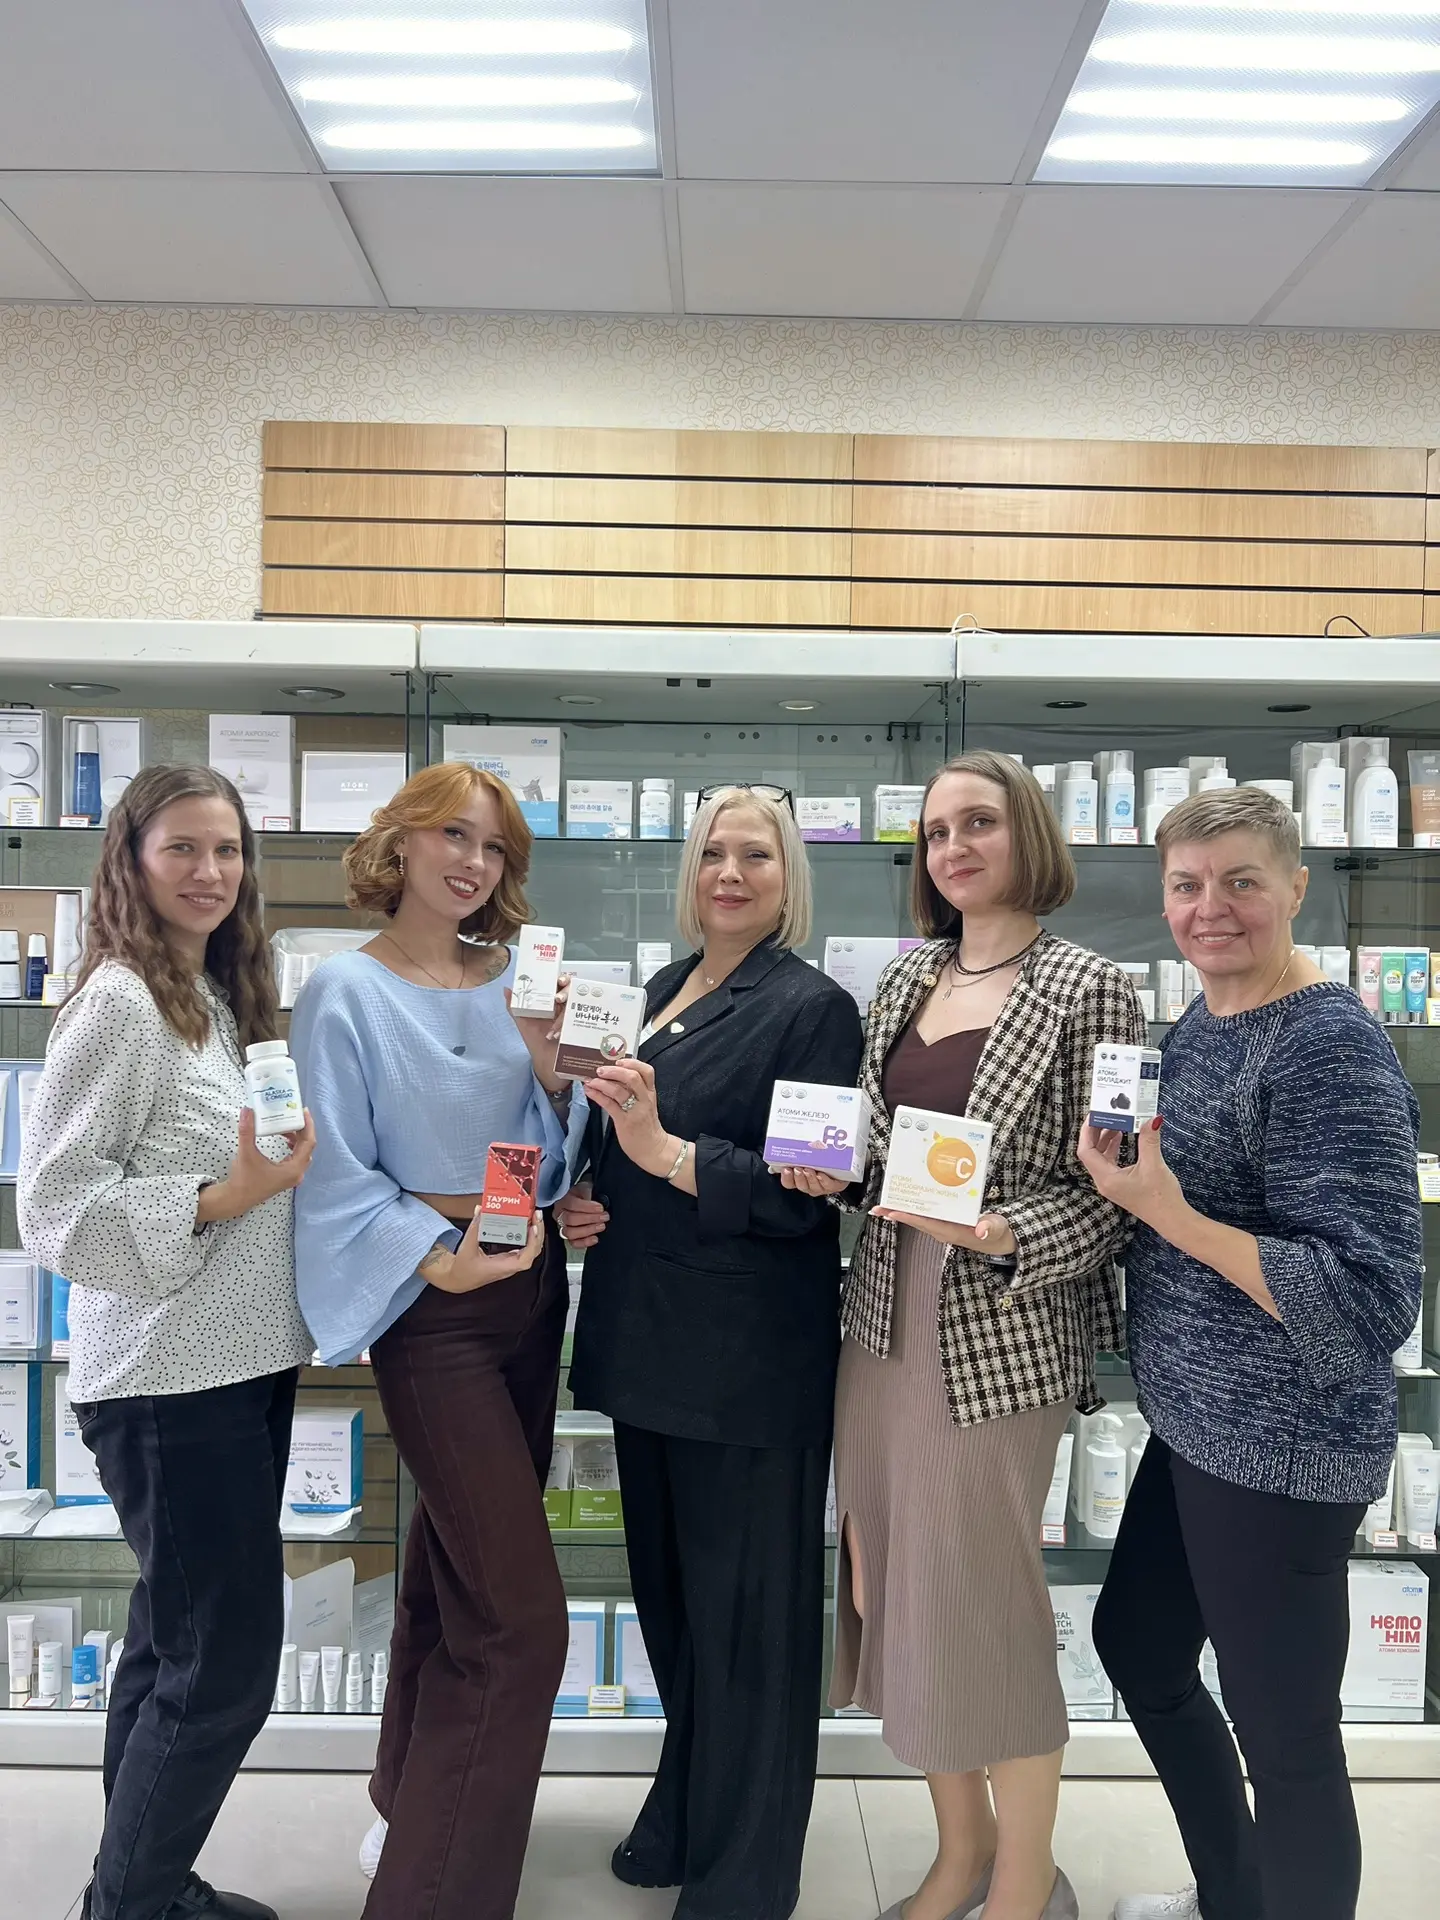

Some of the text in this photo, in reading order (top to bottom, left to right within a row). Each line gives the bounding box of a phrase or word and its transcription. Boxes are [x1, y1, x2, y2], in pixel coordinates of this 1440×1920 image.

[533, 943, 558, 952] HEMO
[540, 950, 557, 958] HIM
[1097, 1076, 1132, 1085] ШИЛАДЖИТ
[777, 1108, 800, 1116] АТОМИ
[800, 1110, 830, 1120] ЖЕЛЕЗО
[822, 1125, 848, 1150] Fe
[486, 1195, 521, 1205] ТАУРИН
[485, 1202, 501, 1210] 500
[1054, 1612, 1071, 1620] EAL
[1056, 1620, 1072, 1628] TCH
[1370, 1614, 1422, 1630] HEMO
[1385, 1630, 1420, 1644] HIM
